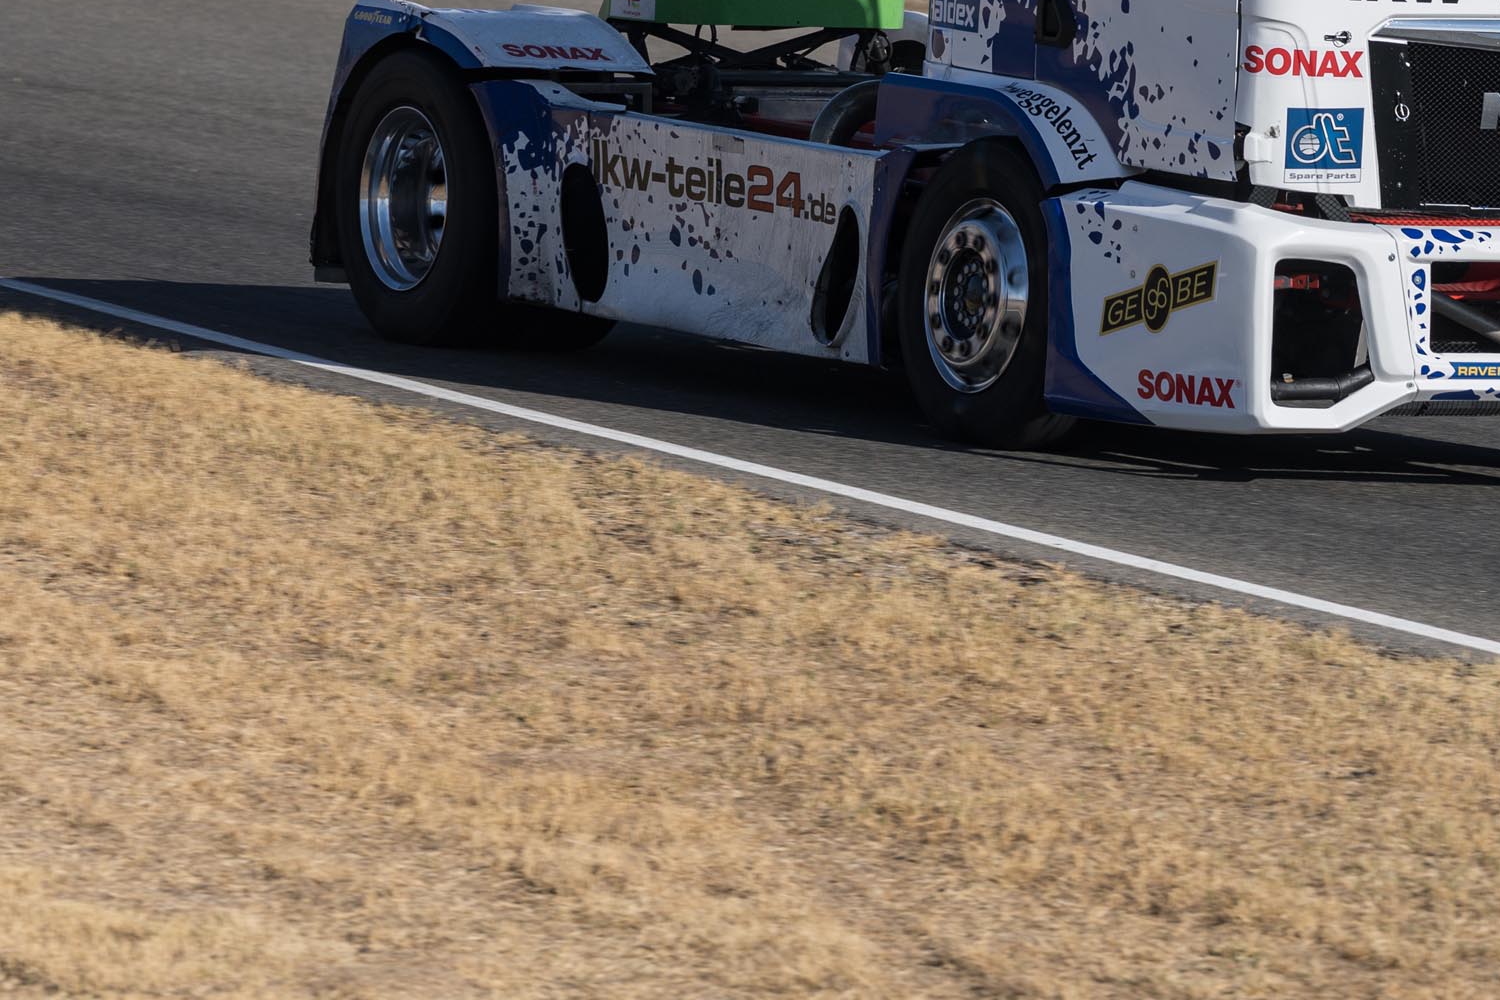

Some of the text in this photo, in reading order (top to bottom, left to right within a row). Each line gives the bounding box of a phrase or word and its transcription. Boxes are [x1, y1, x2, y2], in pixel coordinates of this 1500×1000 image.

[502, 44, 613, 61] SONAX
[1244, 45, 1363, 78] SONAX
[593, 138, 836, 226] lkw-teile24.de
[1289, 171, 1357, 180] Spare Parts
[1137, 369, 1236, 409] SONAX
